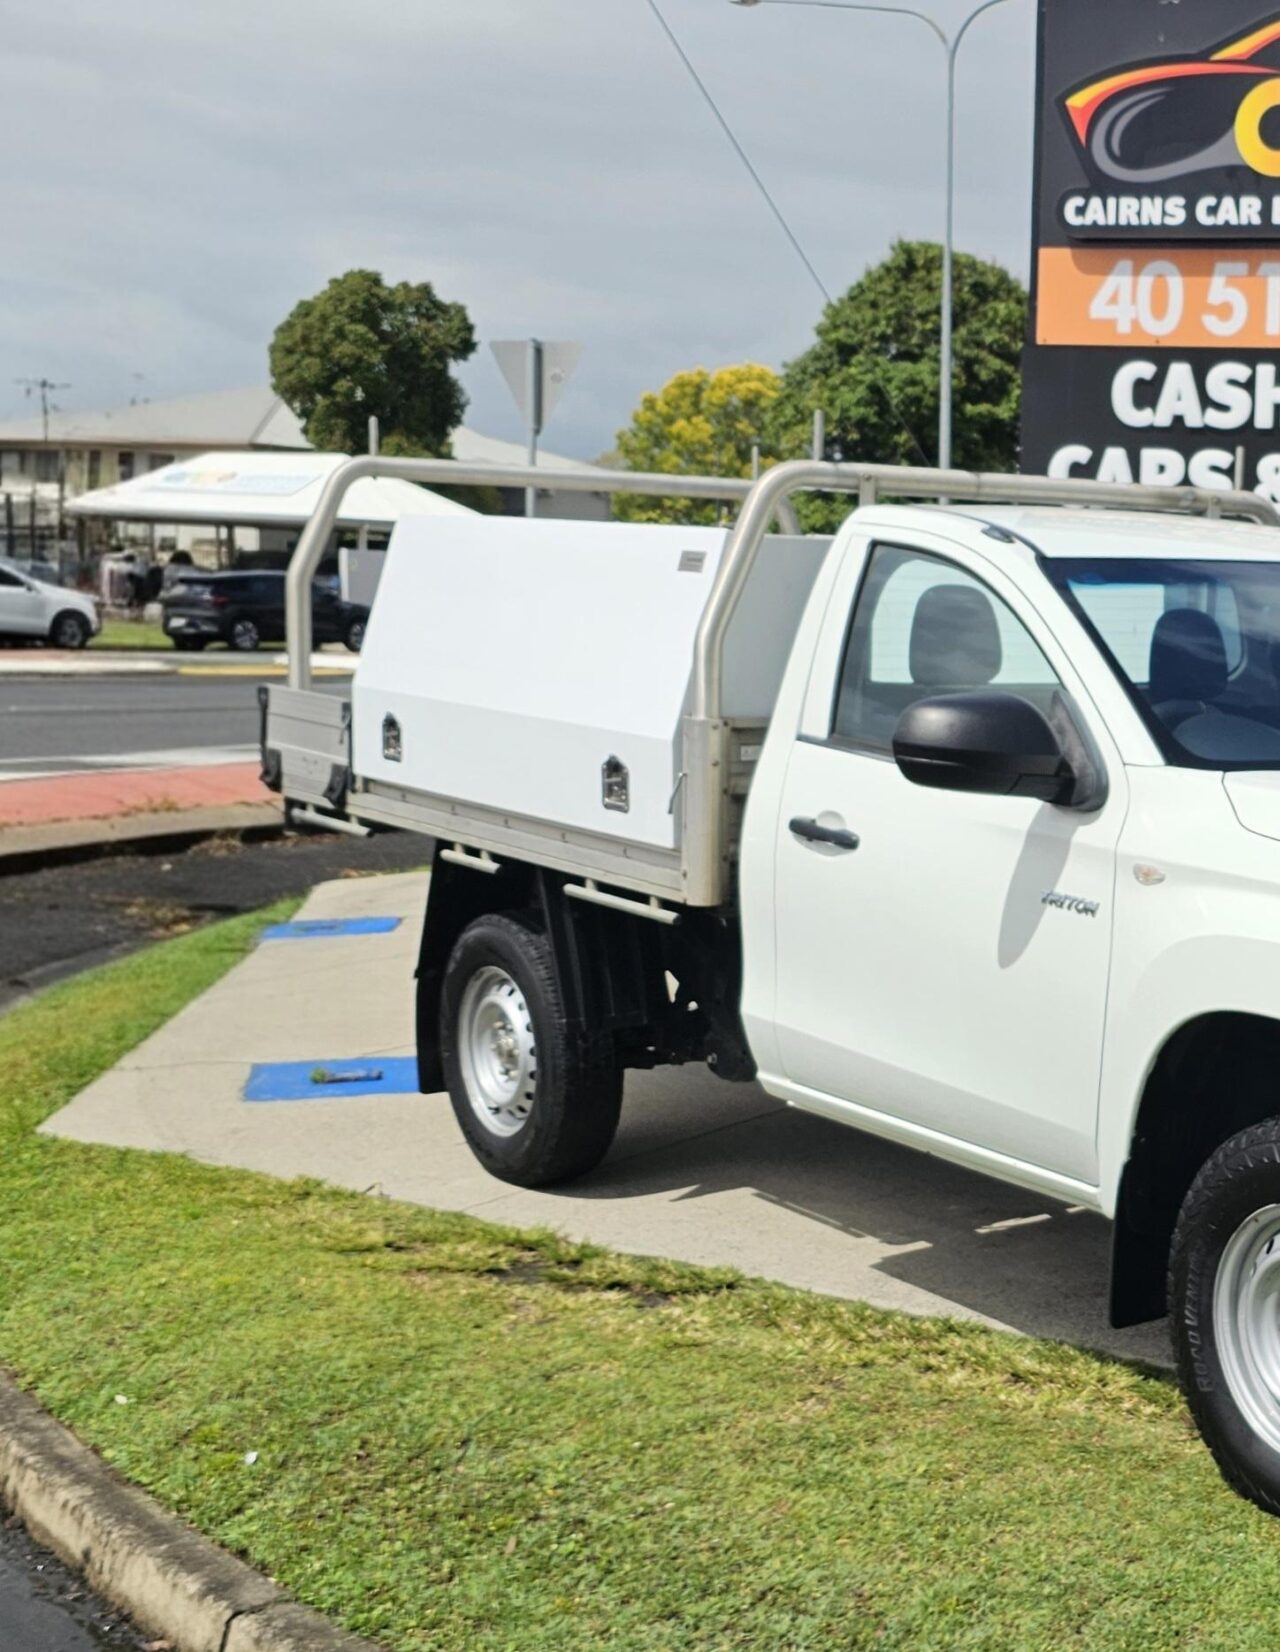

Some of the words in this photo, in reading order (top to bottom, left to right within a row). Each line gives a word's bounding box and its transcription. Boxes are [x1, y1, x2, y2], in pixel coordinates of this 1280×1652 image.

[1064, 195, 1187, 227] CAIRNS
[1195, 195, 1262, 226] CAR
[1089, 259, 1184, 337] 40
